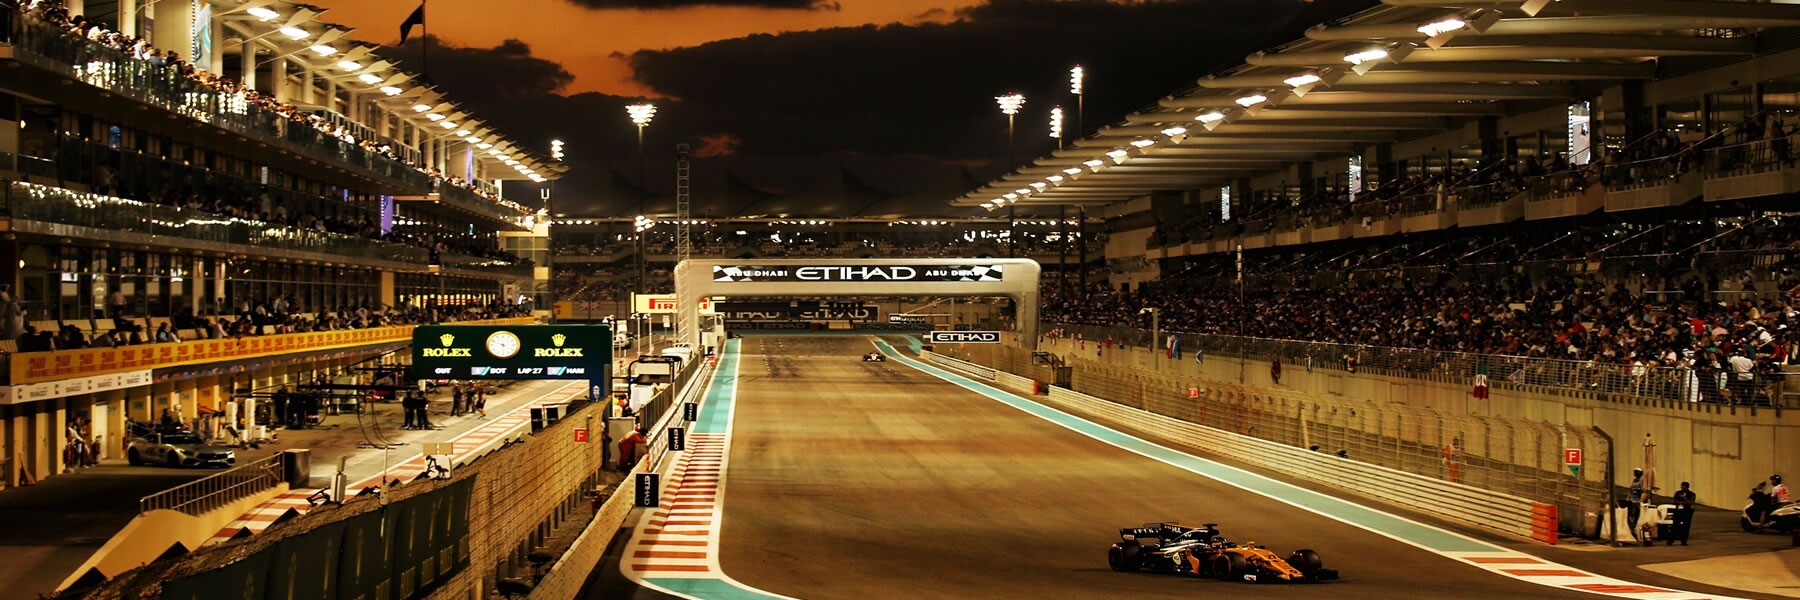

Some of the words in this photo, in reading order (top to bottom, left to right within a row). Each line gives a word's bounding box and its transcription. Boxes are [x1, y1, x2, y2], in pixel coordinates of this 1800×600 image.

[795, 266, 917, 280] ETIHAD
[936, 333, 996, 341] ETIHAD
[422, 348, 472, 357] ROLEX
[534, 348, 584, 357] ROLEX
[577, 430, 585, 441] F
[1569, 451, 1577, 462] F
